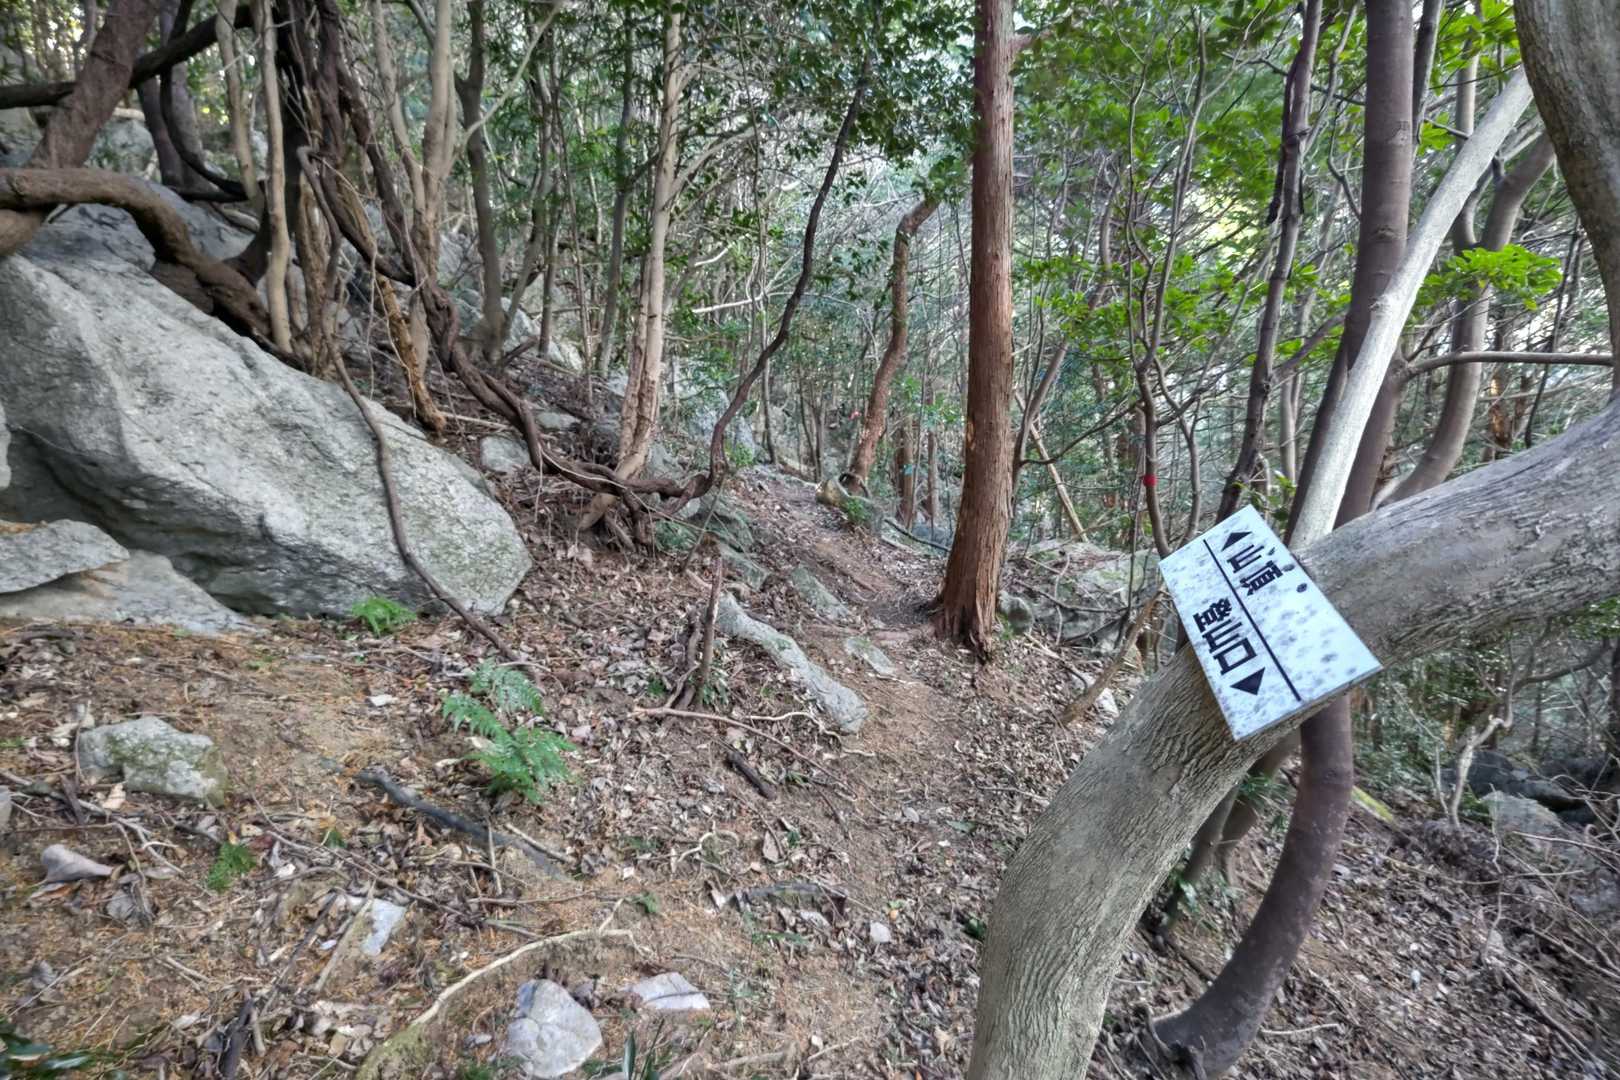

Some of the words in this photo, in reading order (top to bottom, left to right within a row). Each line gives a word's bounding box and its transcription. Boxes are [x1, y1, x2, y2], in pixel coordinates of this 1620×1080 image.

[1227, 544, 1283, 596] 山頂
[1193, 597, 1258, 676] 登山口
